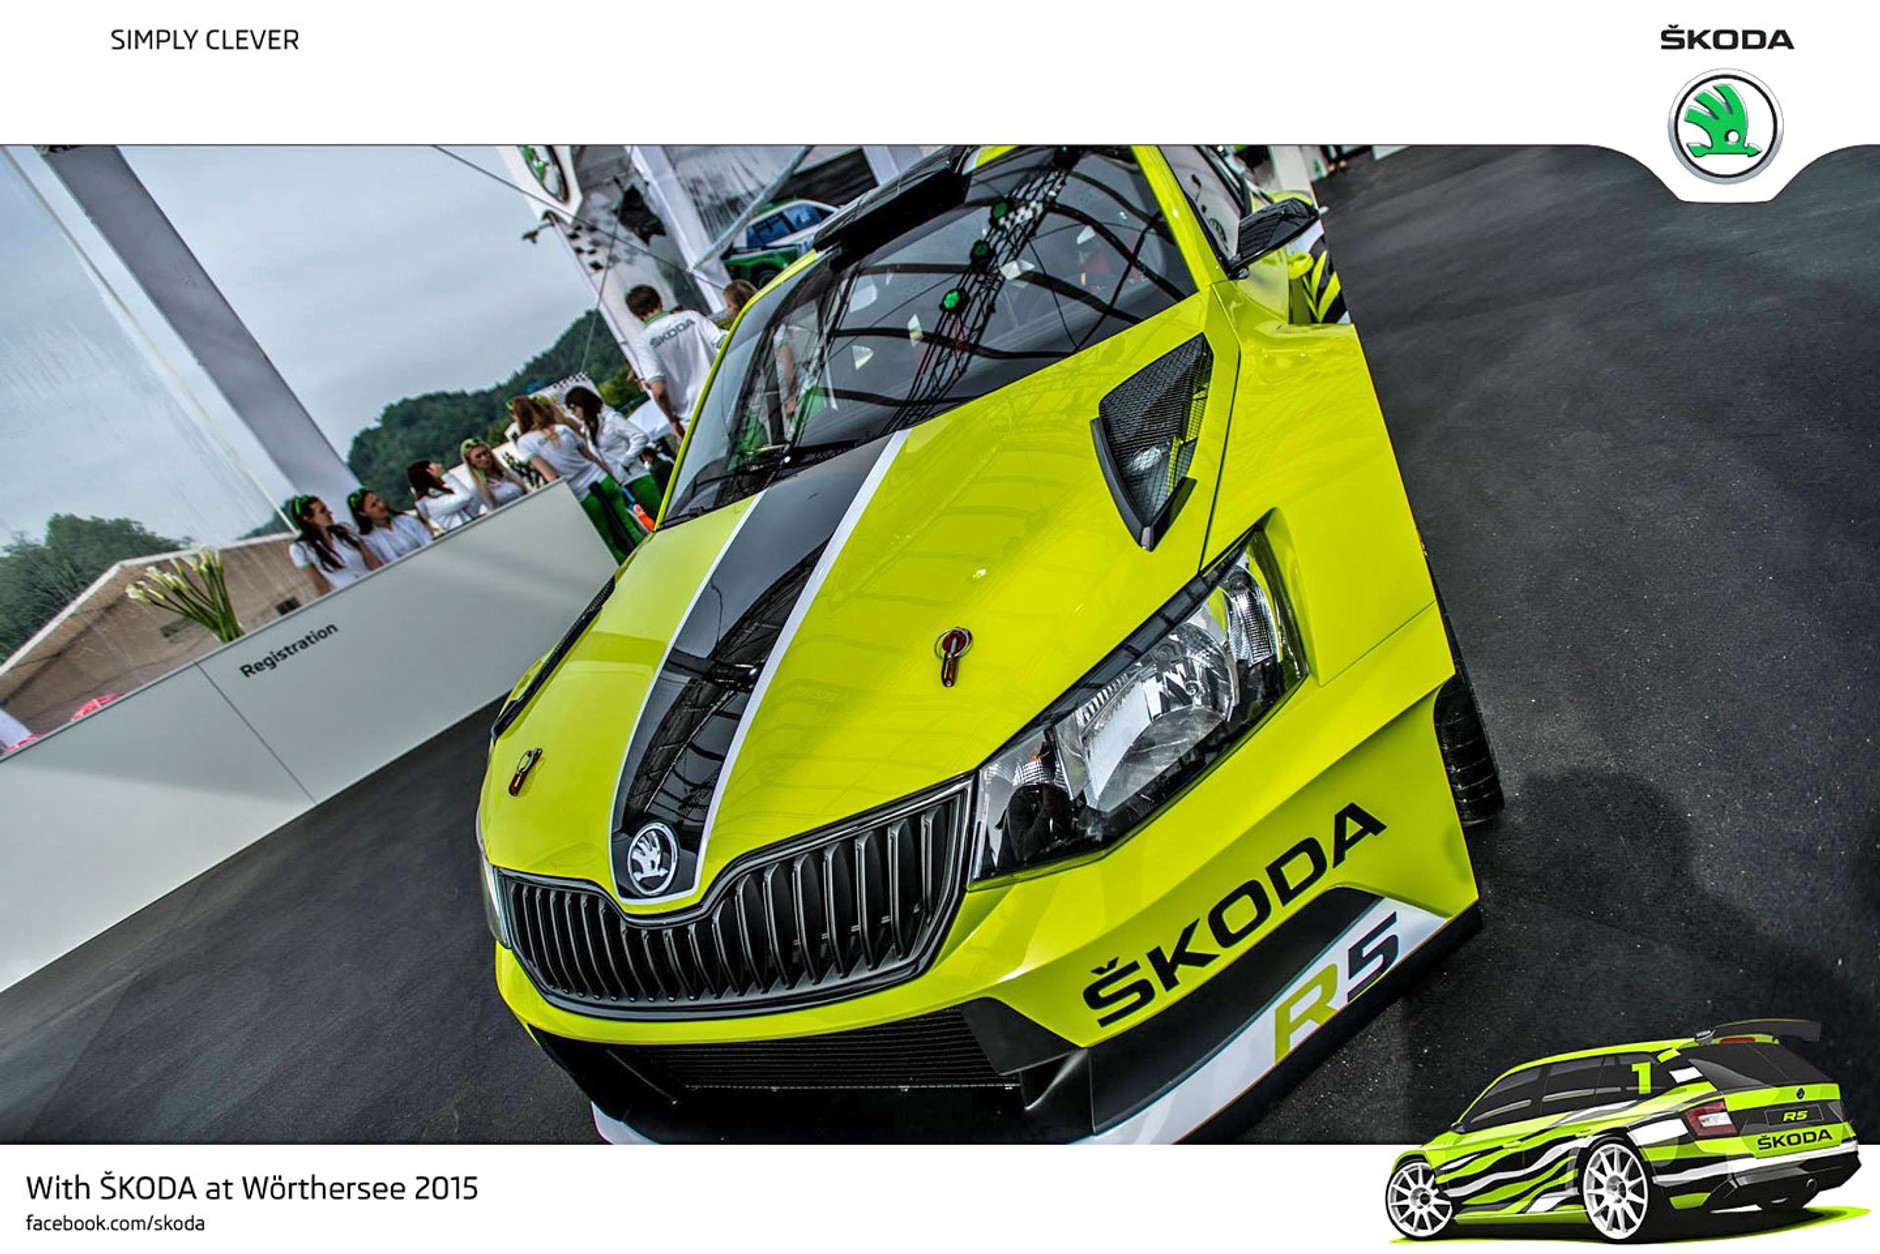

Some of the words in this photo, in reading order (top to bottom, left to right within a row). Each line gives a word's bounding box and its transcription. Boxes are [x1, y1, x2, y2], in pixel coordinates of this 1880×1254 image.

[240, 624, 339, 678] Registration
[1083, 802, 1387, 1028] ŠKODA
[1274, 911, 1400, 1066] R5
